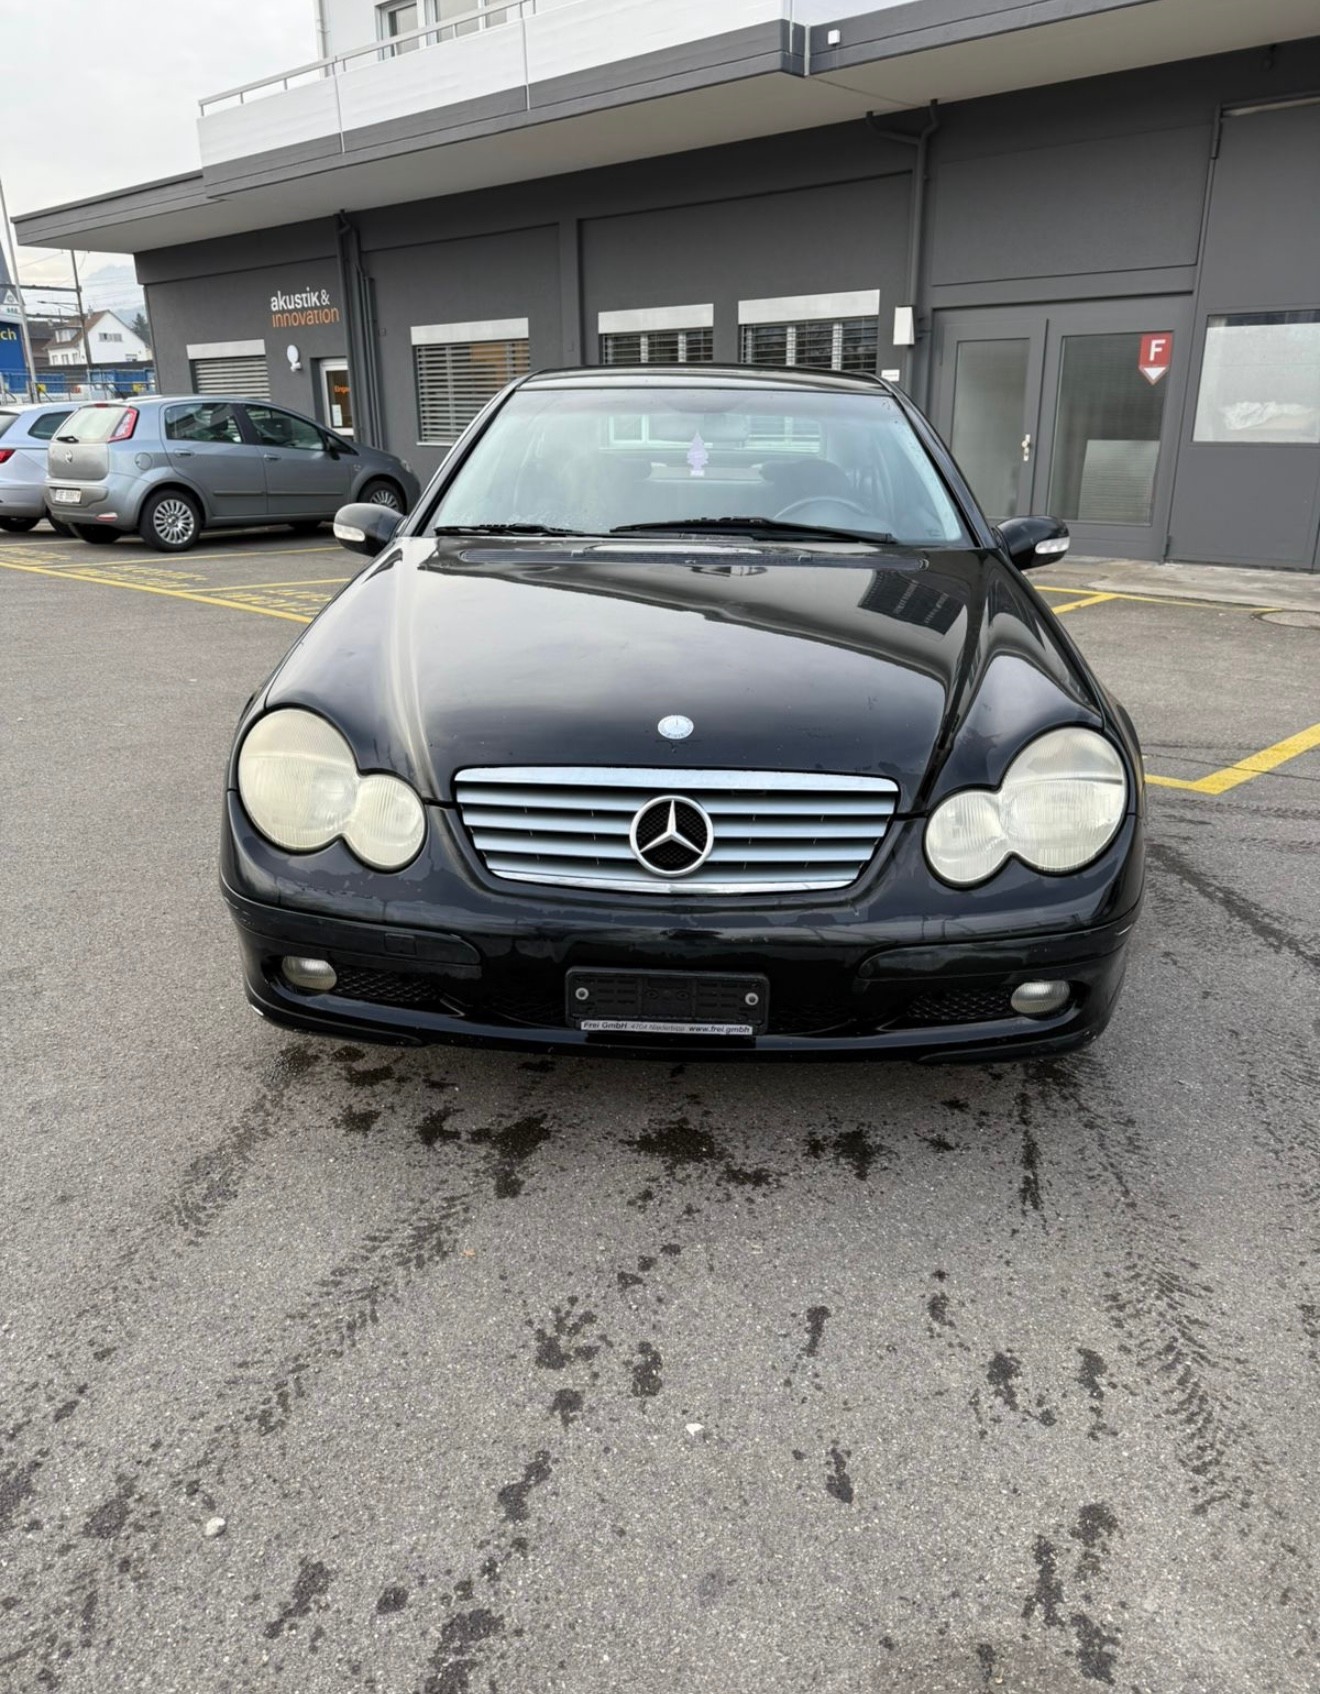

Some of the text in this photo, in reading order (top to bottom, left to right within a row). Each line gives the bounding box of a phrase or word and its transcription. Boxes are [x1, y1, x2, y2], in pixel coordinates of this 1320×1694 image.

[272, 307, 339, 327] innovation
[1150, 339, 1166, 361] F
[584, 1021, 600, 1029] Frei
[601, 1021, 628, 1030] GmbH
[689, 1025, 750, 1034] www.frei.gmbh
